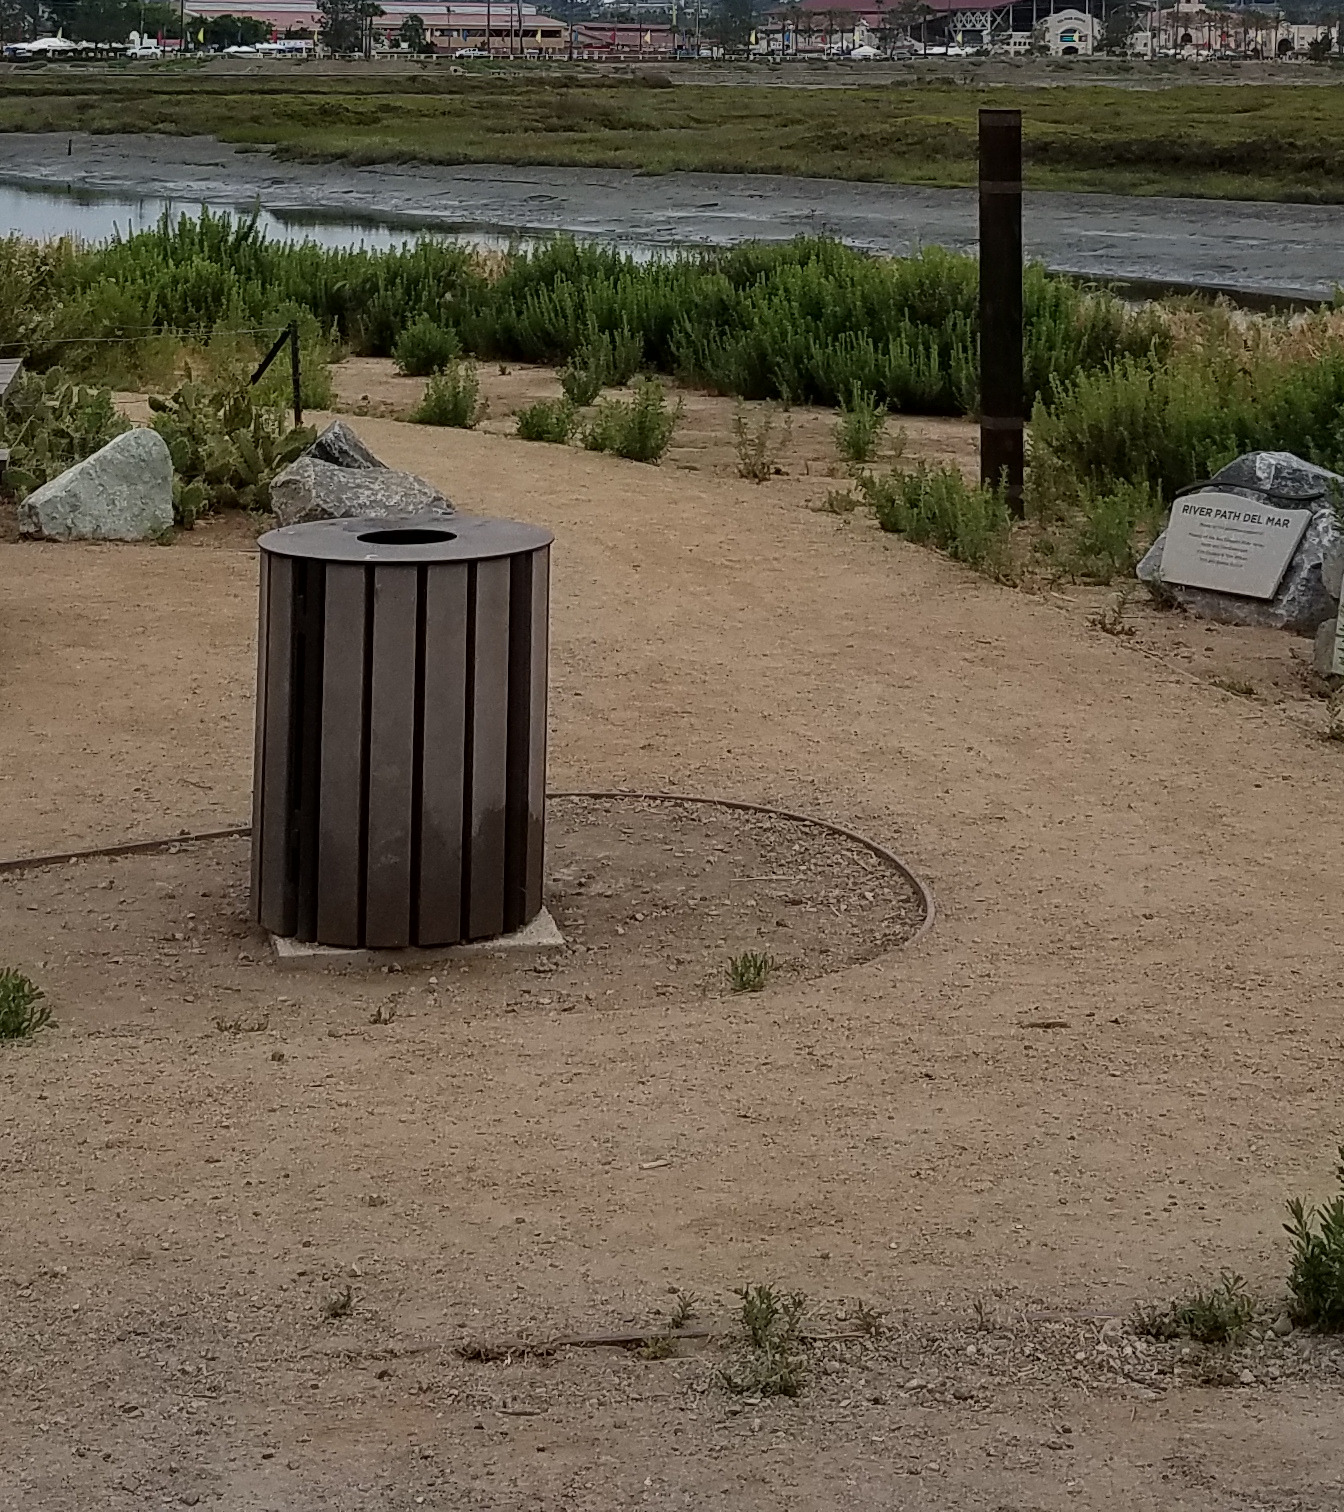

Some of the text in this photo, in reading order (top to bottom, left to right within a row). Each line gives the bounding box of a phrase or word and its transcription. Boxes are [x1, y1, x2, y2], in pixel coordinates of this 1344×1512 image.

[1182, 504, 1213, 518] RIVER
[1214, 509, 1242, 521] PATH
[1242, 513, 1263, 525] DEL
[1266, 516, 1291, 529] MAR
